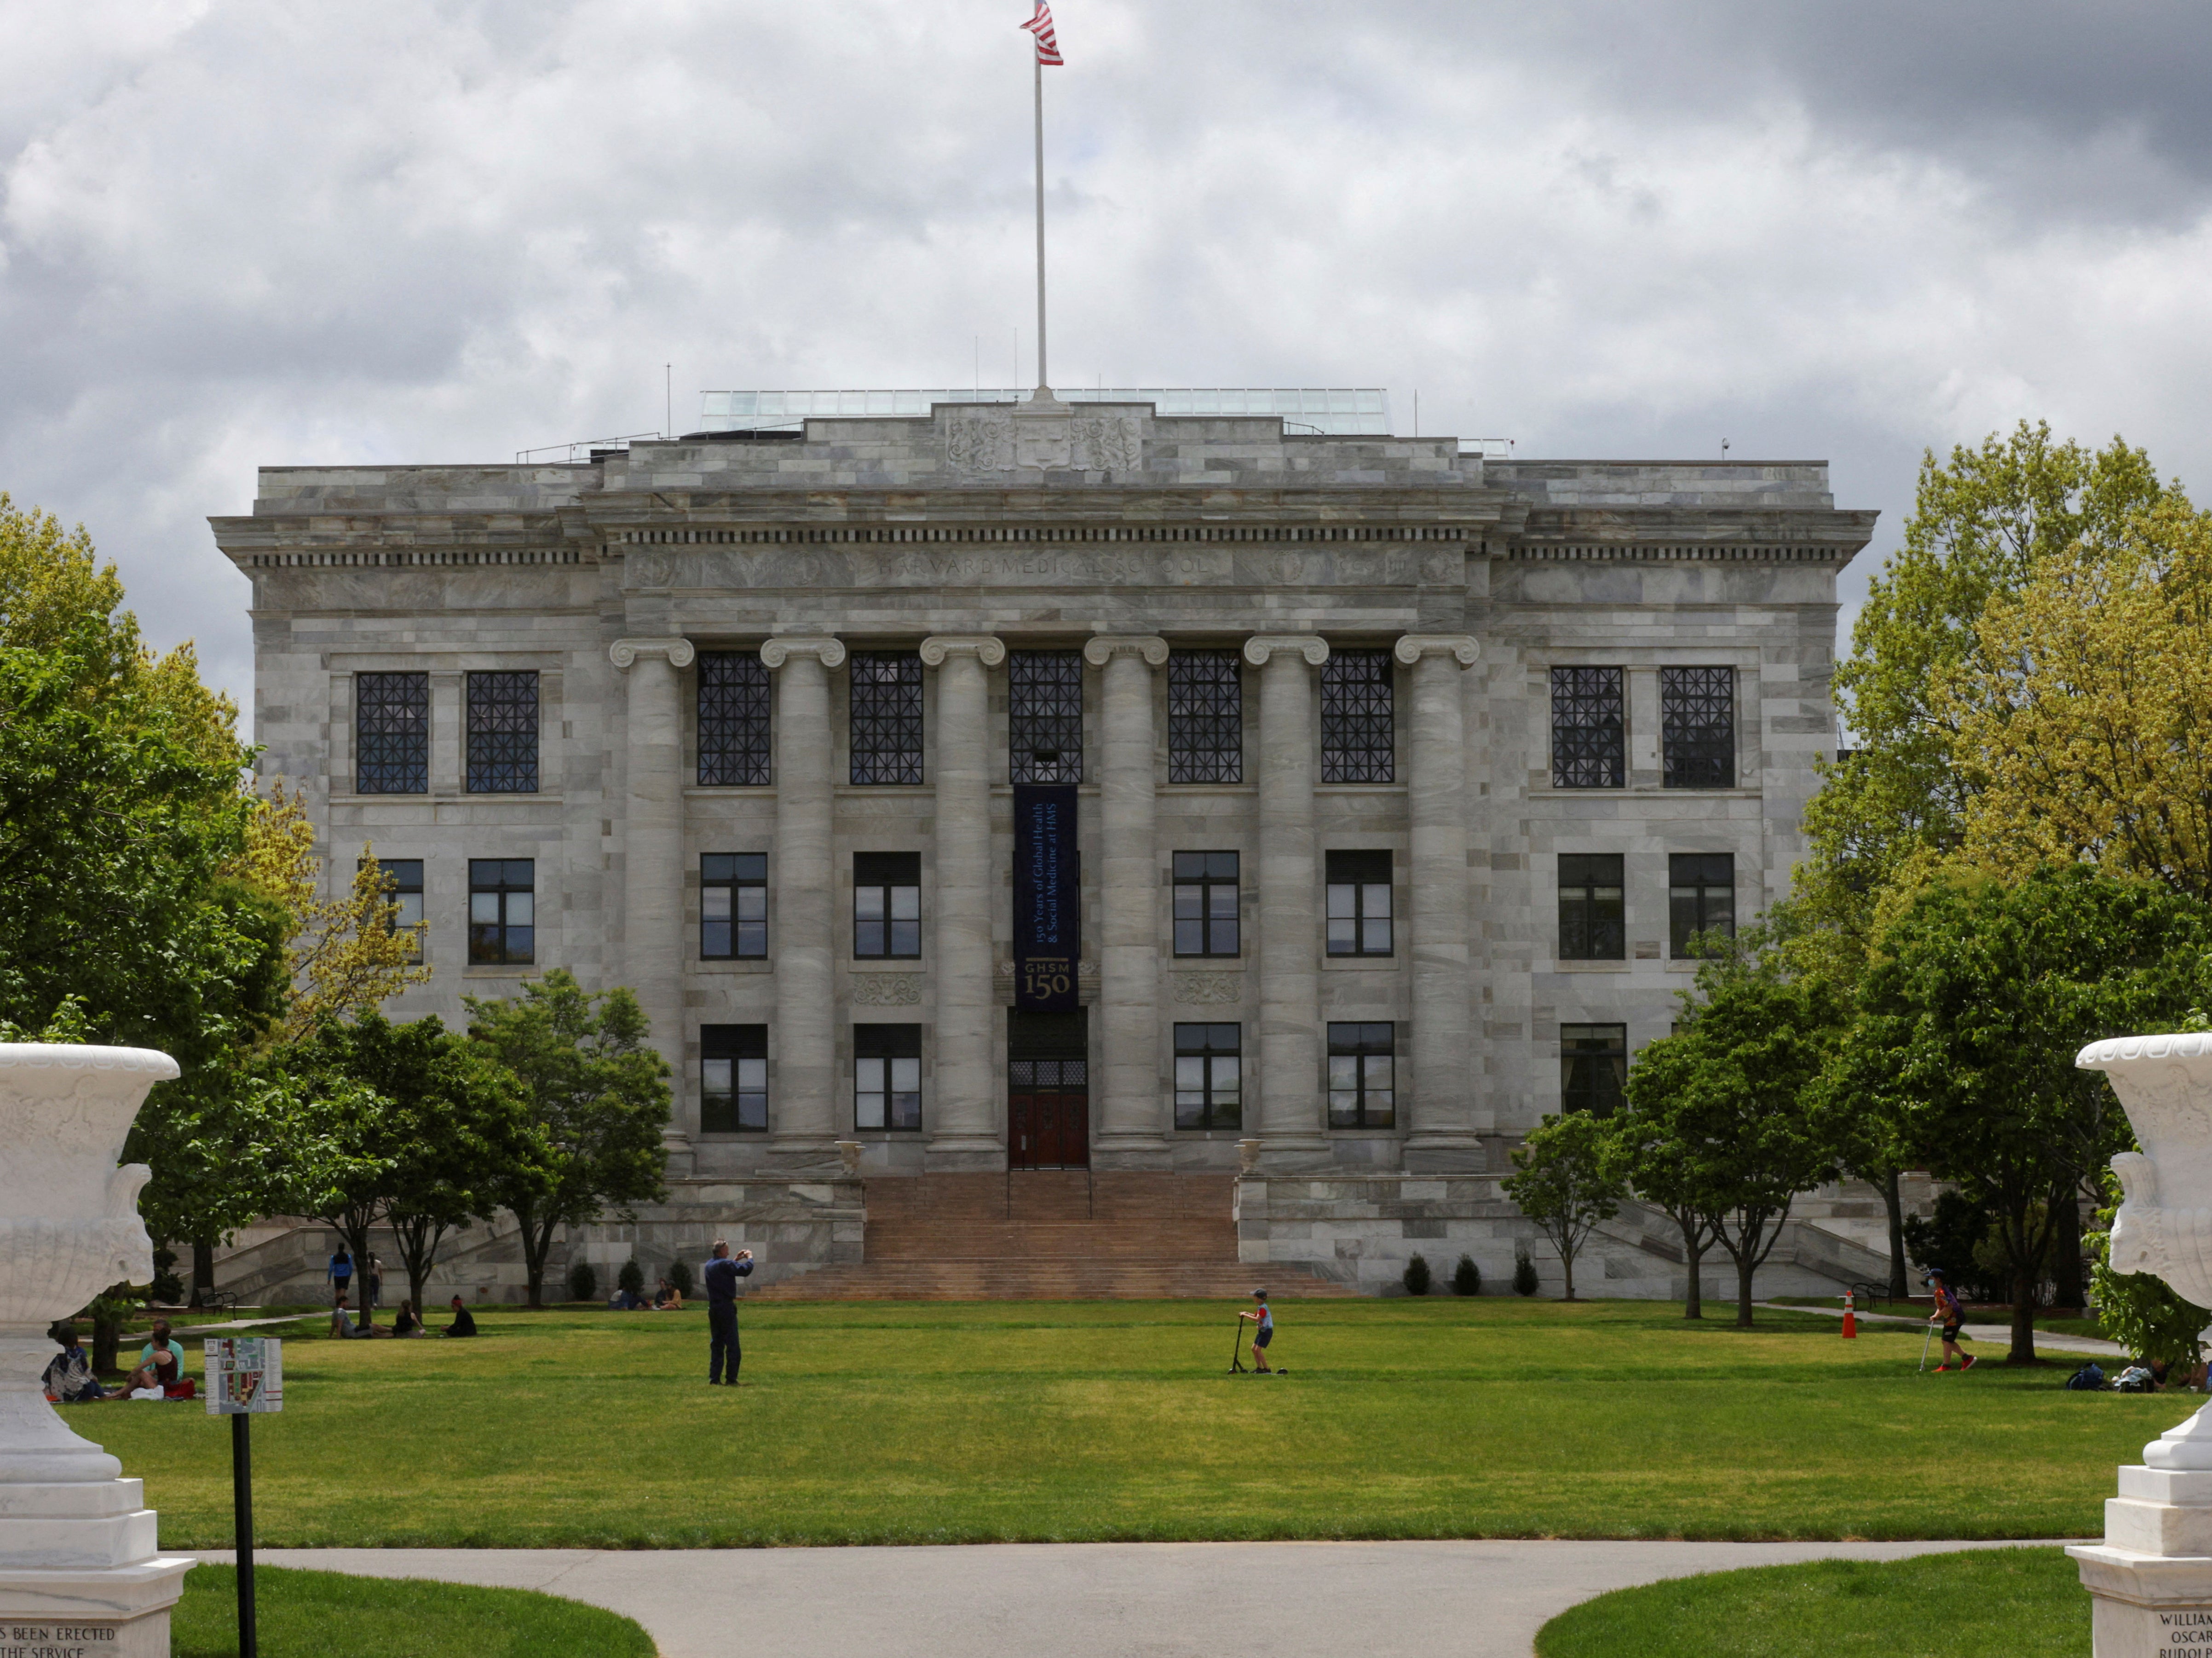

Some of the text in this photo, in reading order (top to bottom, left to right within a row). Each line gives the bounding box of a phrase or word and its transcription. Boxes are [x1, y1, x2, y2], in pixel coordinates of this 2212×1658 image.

[879, 558, 1208, 574] HARVARD MEDICAL SCHOOL
[1033, 804, 1045, 942] 150 Years of Global Health
[1047, 804, 1057, 943] & Social Medicine at HMS
[1025, 963, 1070, 973] GHSM
[1025, 974, 1070, 1000] 150
[13, 1627, 48, 1640] BEEN
[57, 1628, 115, 1641] ERECTED
[2172, 1630, 2212, 1643] OSCAR
[0, 1647, 84, 1658] THE SERVICE
